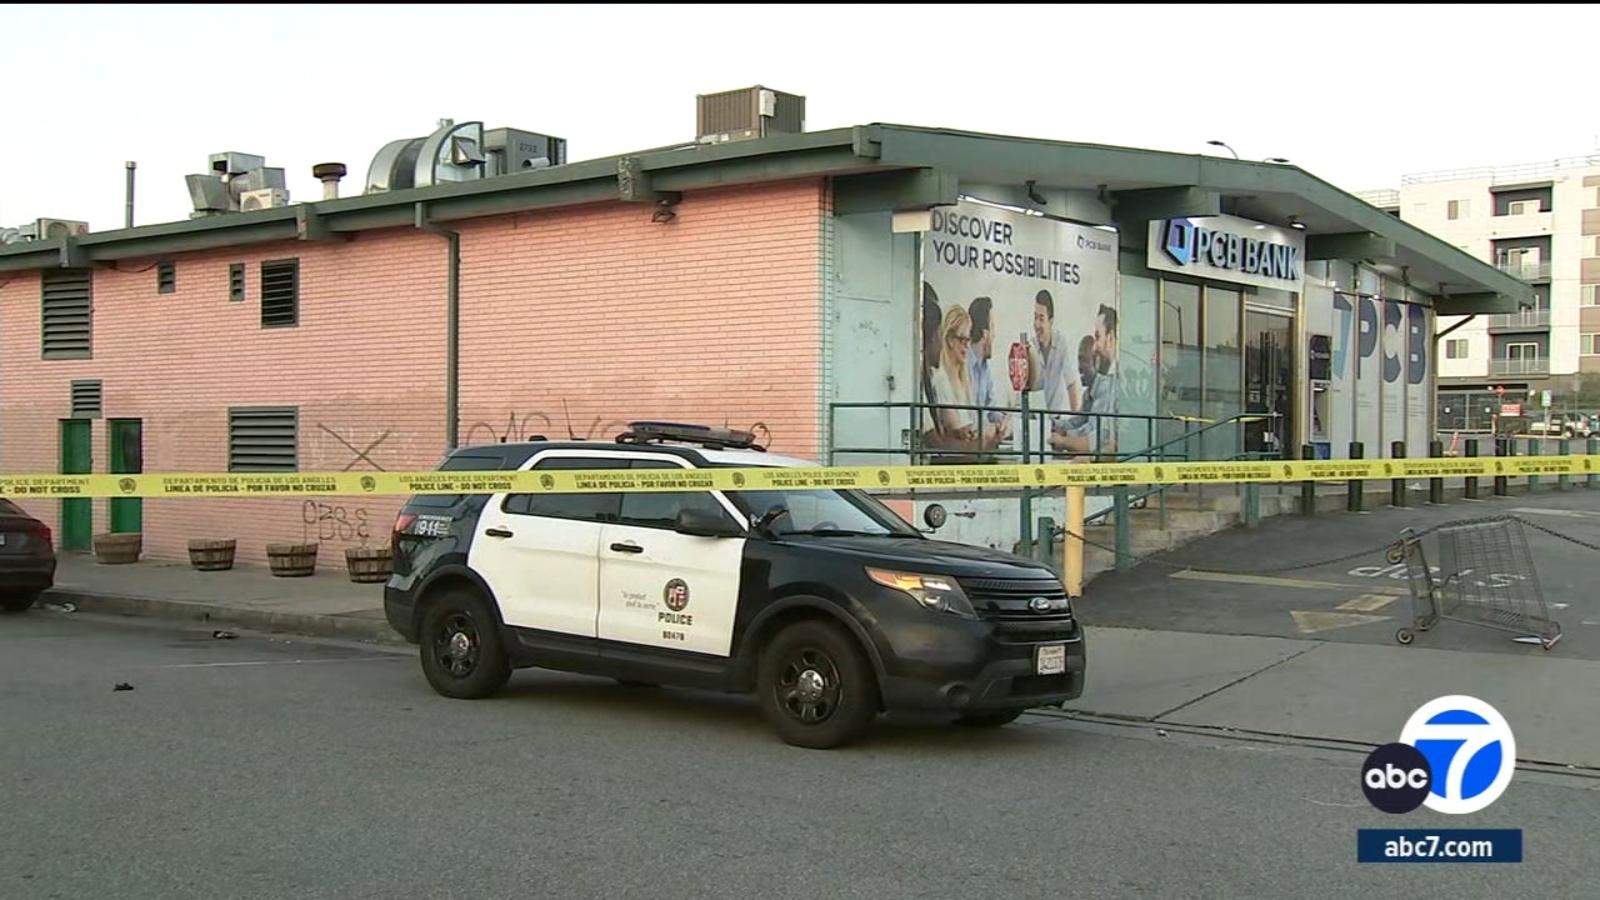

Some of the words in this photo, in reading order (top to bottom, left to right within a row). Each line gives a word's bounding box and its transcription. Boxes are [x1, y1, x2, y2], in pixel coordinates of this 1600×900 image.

[932, 210, 1013, 246] DISCOVER
[933, 240, 979, 269] YOUR
[983, 250, 1081, 285] POSSIBILITIES
[1194, 226, 1241, 269] PCB
[1243, 238, 1299, 280] BANK
[1356, 297, 1426, 385] PCB
[14, 486, 27, 494] DO
[30, 486, 48, 494] NOT
[50, 486, 80, 494] CROSS
[33, 478, 90, 486] DEPARTMENT
[419, 519, 440, 536] 911
[658, 612, 693, 626] POLICE
